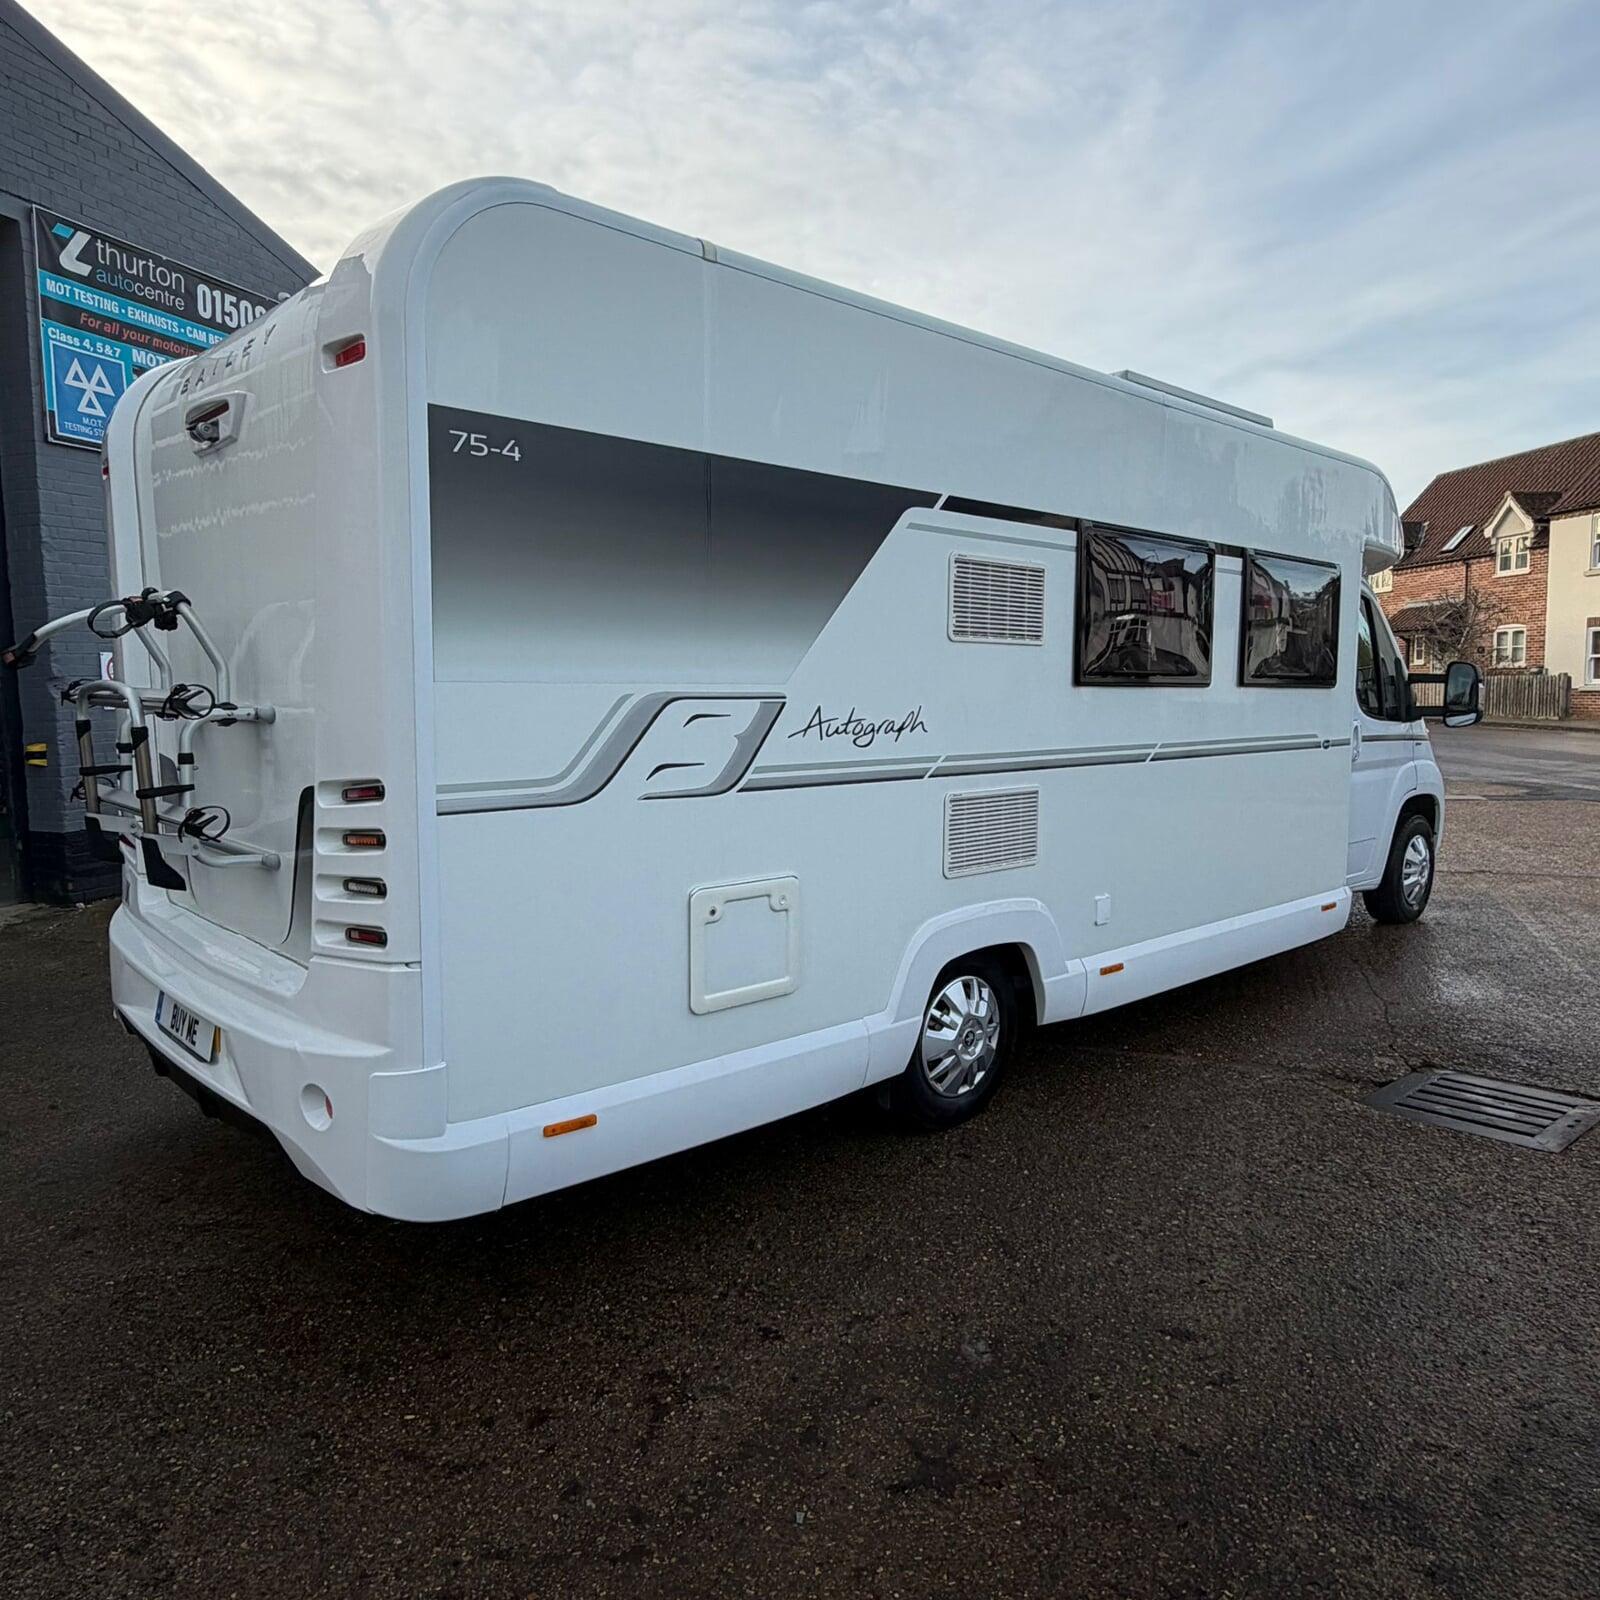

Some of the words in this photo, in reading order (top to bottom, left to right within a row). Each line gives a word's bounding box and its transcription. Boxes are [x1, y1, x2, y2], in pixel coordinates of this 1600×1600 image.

[96, 238, 185, 293] thurton
[96, 268, 185, 311] autocentre
[46, 278, 72, 298] MOT
[73, 287, 119, 314] TESTING
[127, 306, 179, 333] EXHAUSTS
[186, 326, 207, 344] CAM
[80, 312, 101, 329] For
[103, 322, 120, 335] all
[122, 328, 151, 344] your
[47, 327, 80, 347] Class
[96, 342, 122, 358] 5&7
[180, 323, 277, 396] BAILEY
[64, 421, 93, 435] TESTING
[448, 429, 522, 462] 75-4
[787, 704, 929, 748] Autograph
[170, 1003, 188, 1038] BUY
